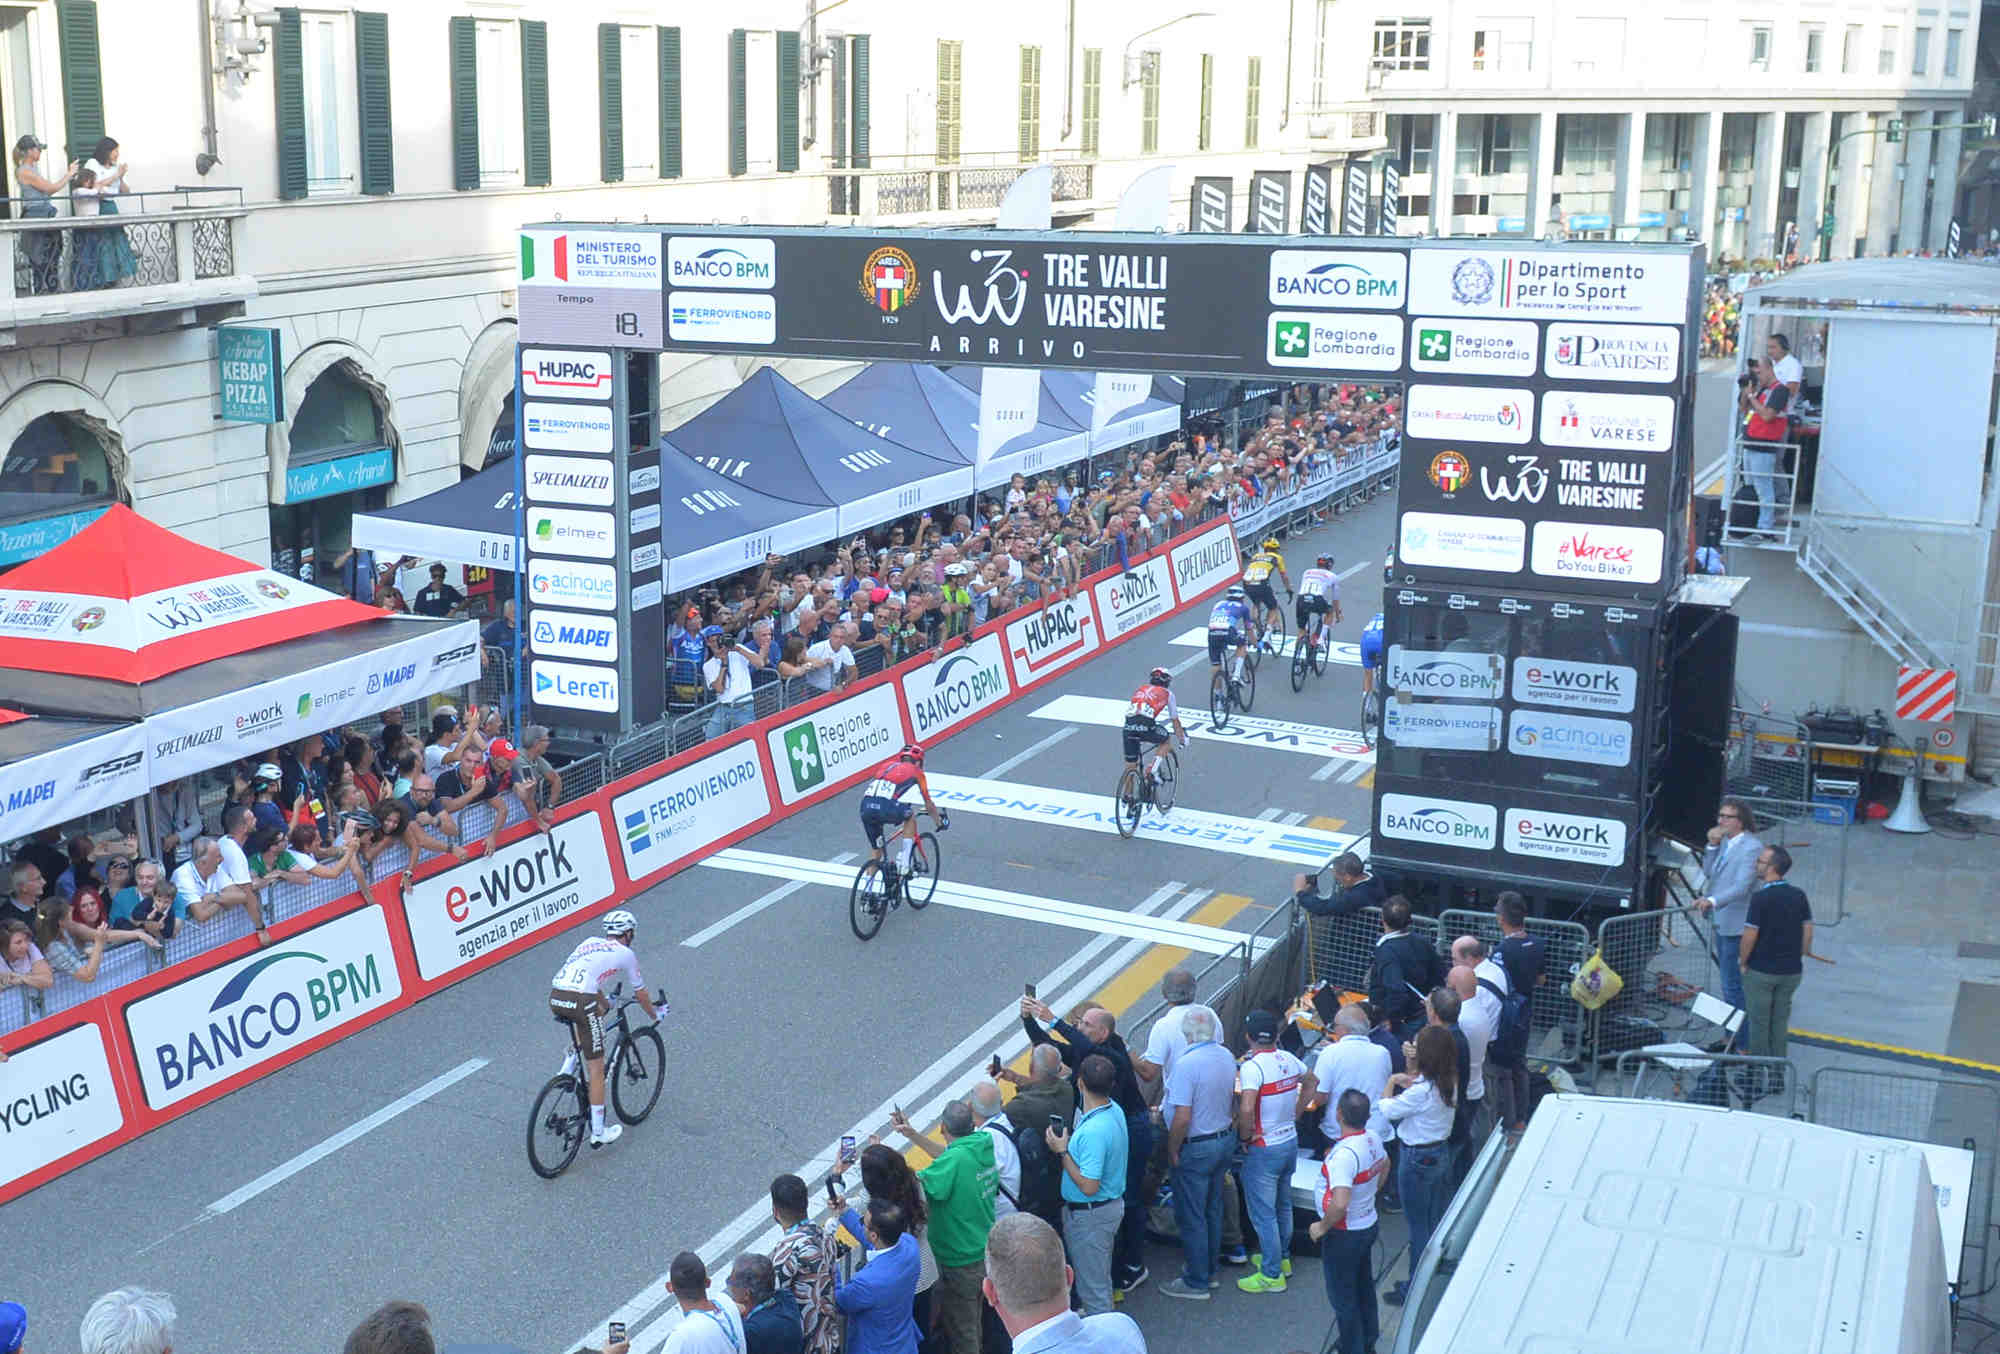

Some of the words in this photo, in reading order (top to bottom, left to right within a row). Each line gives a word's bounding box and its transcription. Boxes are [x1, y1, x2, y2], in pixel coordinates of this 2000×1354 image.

[576, 241, 641, 253] MINISTERO
[576, 254, 599, 265] DEL
[603, 255, 657, 266] TURISMO
[674, 261, 732, 277] BANCO
[736, 262, 769, 278] BPM
[1519, 260, 1644, 280] Dipartimento
[1043, 254, 1089, 287] TRE
[1098, 255, 1168, 290] VALLI
[1277, 277, 1350, 295] BANCO
[1356, 279, 1398, 296] BPM
[1517, 284, 1547, 300] per
[1553, 281, 1569, 297] lo
[1575, 282, 1626, 302] Sport
[557, 294, 594, 304] Tempo
[690, 308, 772, 320] FERROVIENORD
[1044, 293, 1166, 330] VARESINE
[1314, 327, 1377, 343] Regione
[1455, 335, 1513, 349] Regione
[930, 335, 1084, 358] ARRIVO
[1314, 340, 1395, 356] Lombardia
[1455, 347, 1530, 361] Lombardia
[223, 361, 267, 381] KEBAP
[539, 361, 596, 379] HUPAC
[1601, 354, 1669, 371] VARESE
[225, 384, 267, 404] PIZZA
[543, 419, 610, 431] FERROVIENORD
[1591, 427, 1656, 442] VARESE
[532, 471, 609, 489] SPECIALIZED
[1560, 459, 1592, 482] TRE
[1598, 462, 1646, 485] VALLI
[1557, 484, 1644, 510] VARESINE
[556, 527, 608, 541] elmec
[1177, 536, 1232, 587] SPECIALIZED
[209, 584, 241, 598] VALLI
[1111, 565, 1158, 610] e-work
[200, 595, 254, 614] VARESINE
[558, 625, 611, 647] MAPEI
[1024, 604, 1077, 654] HUPAC
[382, 663, 416, 689] MAPEI
[557, 674, 614, 700] LereTi
[1460, 674, 1496, 689] BPM
[1527, 668, 1619, 691] e-work
[314, 686, 355, 708] elmec
[916, 680, 970, 731] BANCO
[971, 664, 1002, 701] BPM
[235, 700, 283, 729] e-work
[1404, 717, 1497, 729] FERROVIENORD
[819, 710, 871, 745] Regione
[155, 725, 223, 759] SPECIALIZED
[823, 727, 889, 768] Lombardia
[7, 780, 56, 812] MAPEI
[650, 760, 756, 824] FERROVIENORD
[1387, 815, 1449, 835] BANCO
[1455, 823, 1489, 840] BPM
[1518, 819, 1608, 844] e-work
[446, 833, 573, 923] e-work
[459, 924, 507, 958] agenzia
[510, 913, 530, 938] per
[533, 908, 541, 923] il
[543, 891, 579, 917] lavoro
[156, 992, 301, 1090] BANCO
[306, 953, 381, 1022] BPM
[0, 1073, 90, 1133] YCLING
